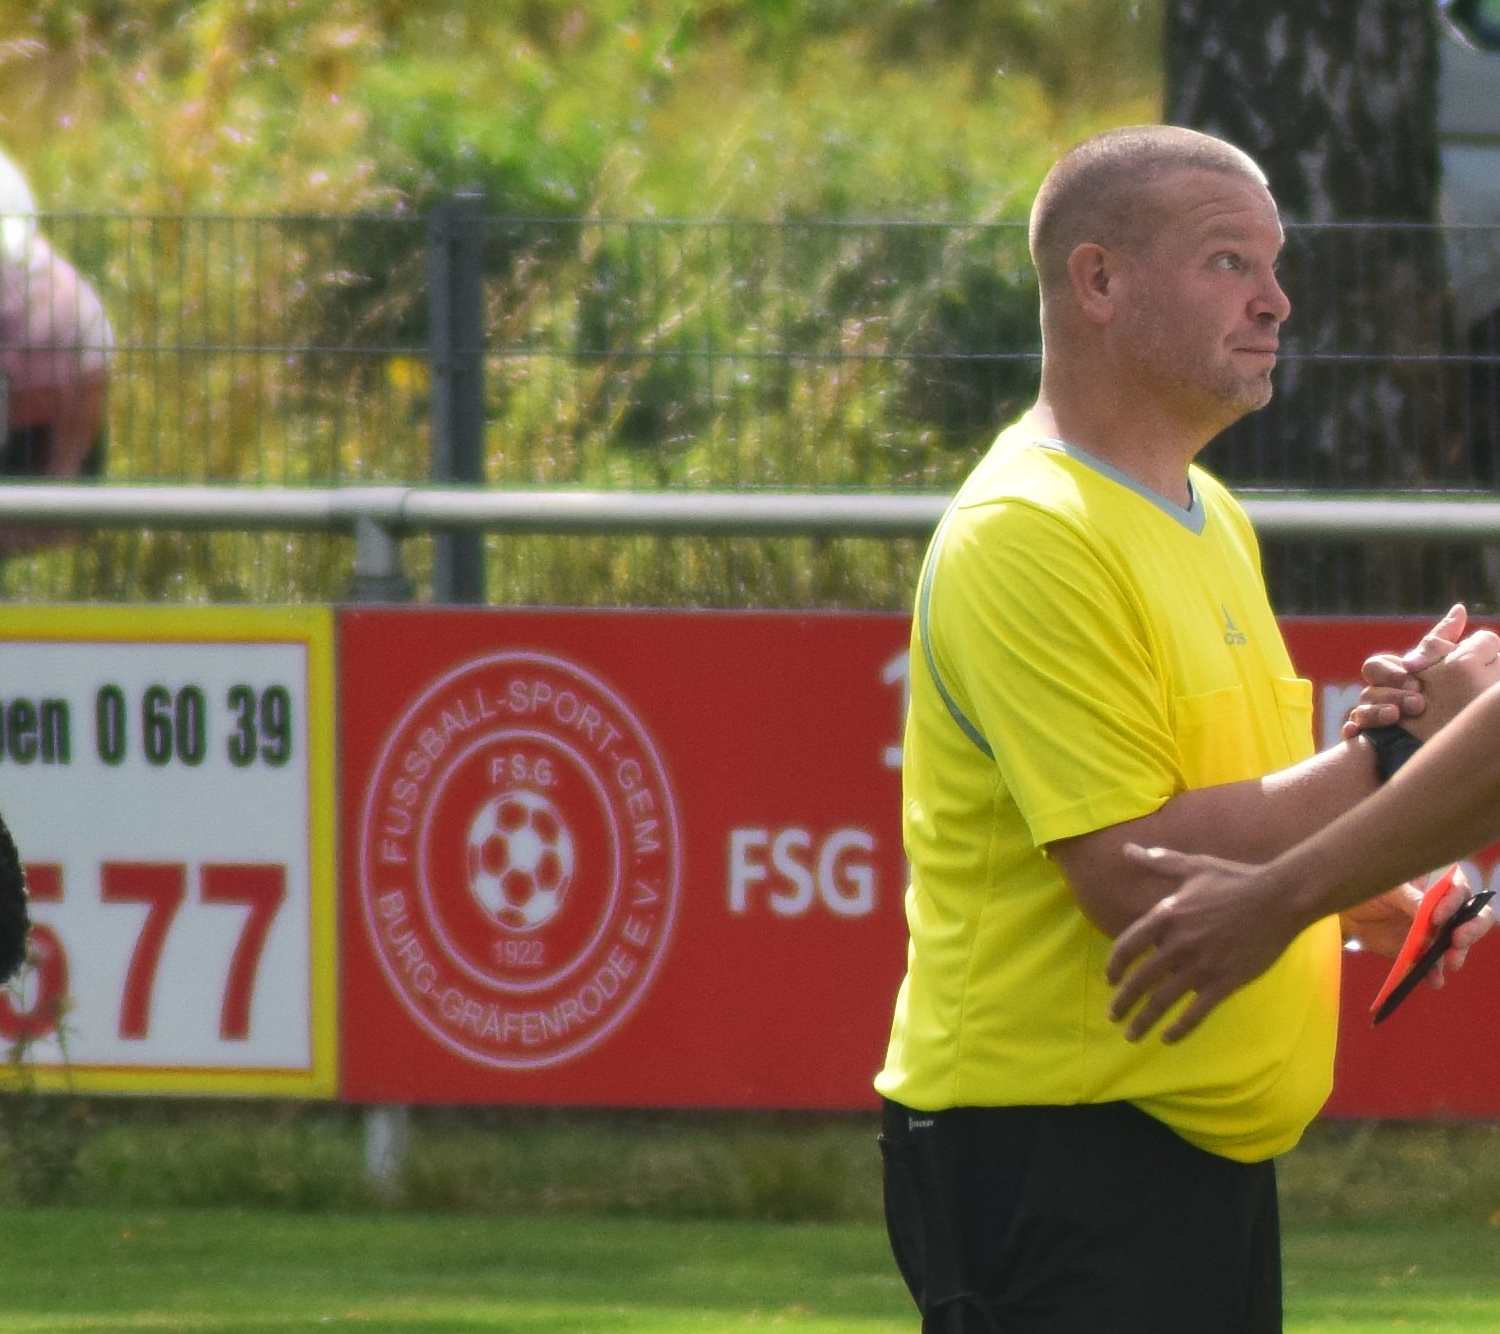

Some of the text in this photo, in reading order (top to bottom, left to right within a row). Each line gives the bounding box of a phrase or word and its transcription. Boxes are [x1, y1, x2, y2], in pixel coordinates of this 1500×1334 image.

[97, 683, 128, 767] 0
[142, 683, 206, 767] 60
[226, 683, 293, 767] 39
[728, 827, 876, 916] FSG
